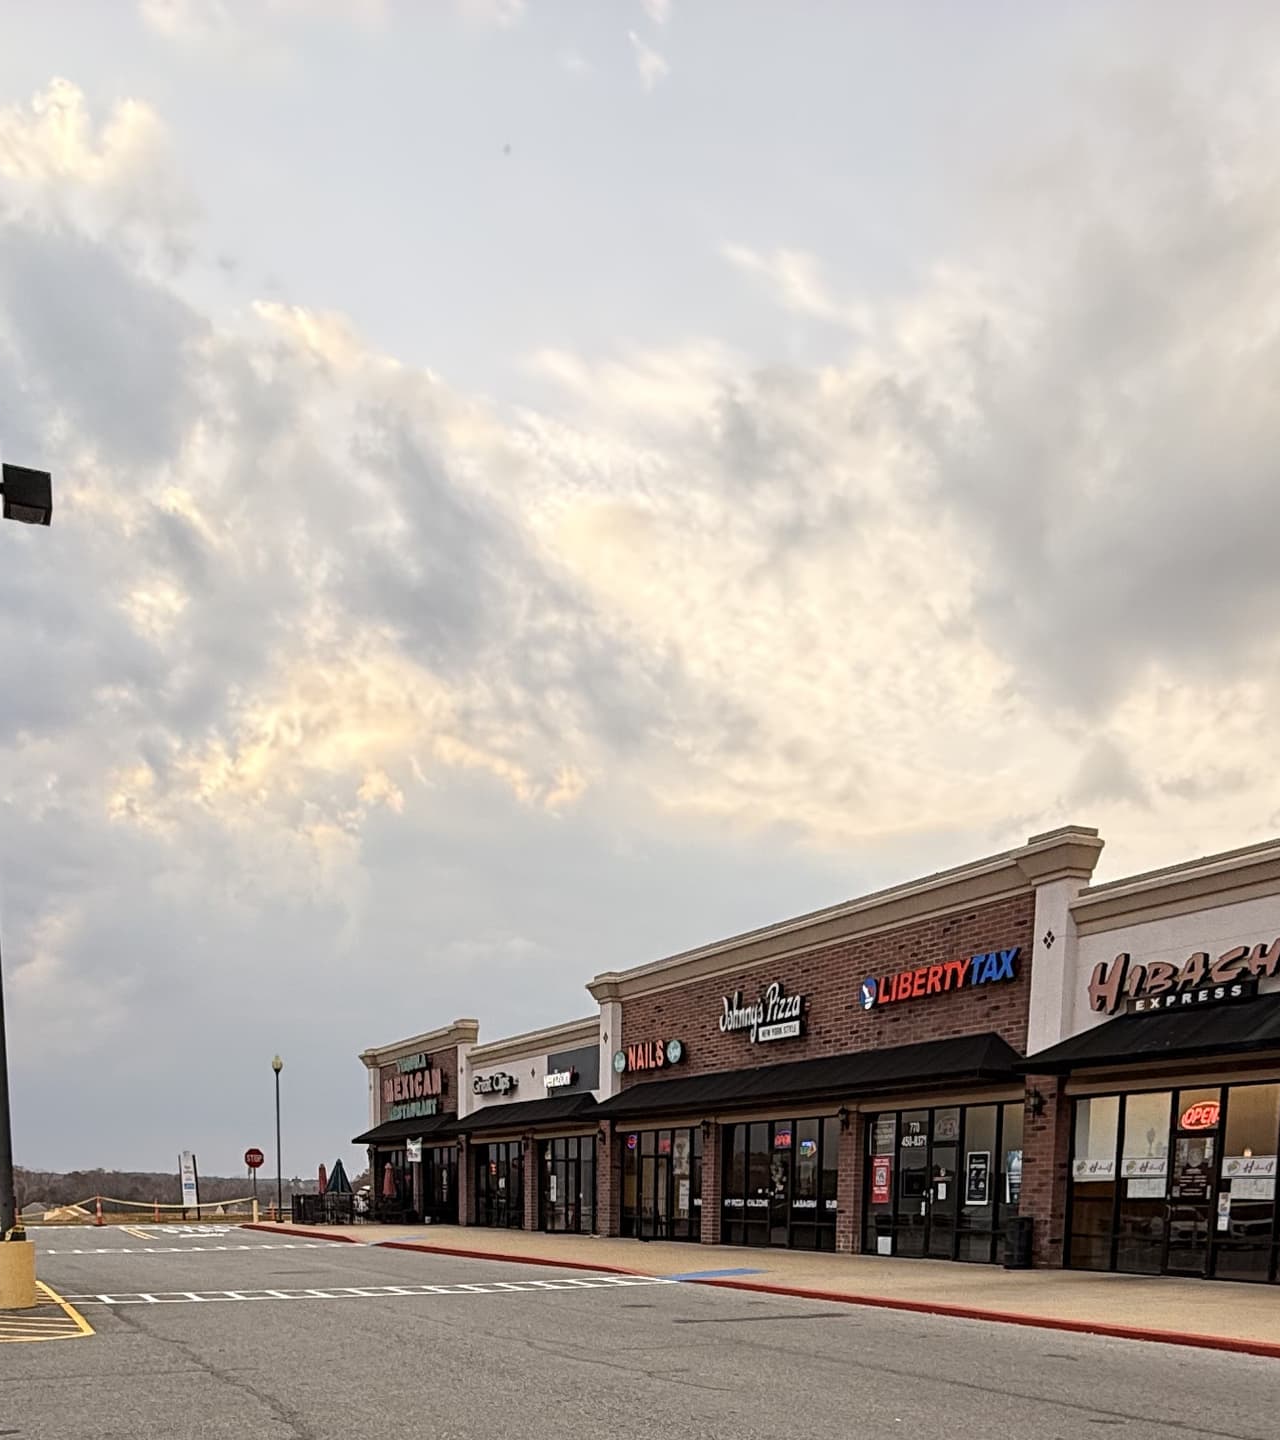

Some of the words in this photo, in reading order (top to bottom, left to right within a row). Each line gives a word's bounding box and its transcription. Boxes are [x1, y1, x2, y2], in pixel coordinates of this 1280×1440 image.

[877, 959, 971, 1005] LIBERTY
[970, 947, 1020, 986] TAX
[1135, 984, 1243, 1012] EXPRESS
[719, 991, 764, 1044] Johnny's
[766, 982, 801, 1023] Pizza
[628, 1039, 665, 1072] NAILS
[384, 1068, 442, 1104] MEXICAN
[472, 1076, 492, 1095] Great
[492, 1071, 511, 1097] Clips
[543, 1069, 571, 1089] verizon
[1184, 1106, 1219, 1125] OPEN
[246, 1154, 262, 1163] STOP
